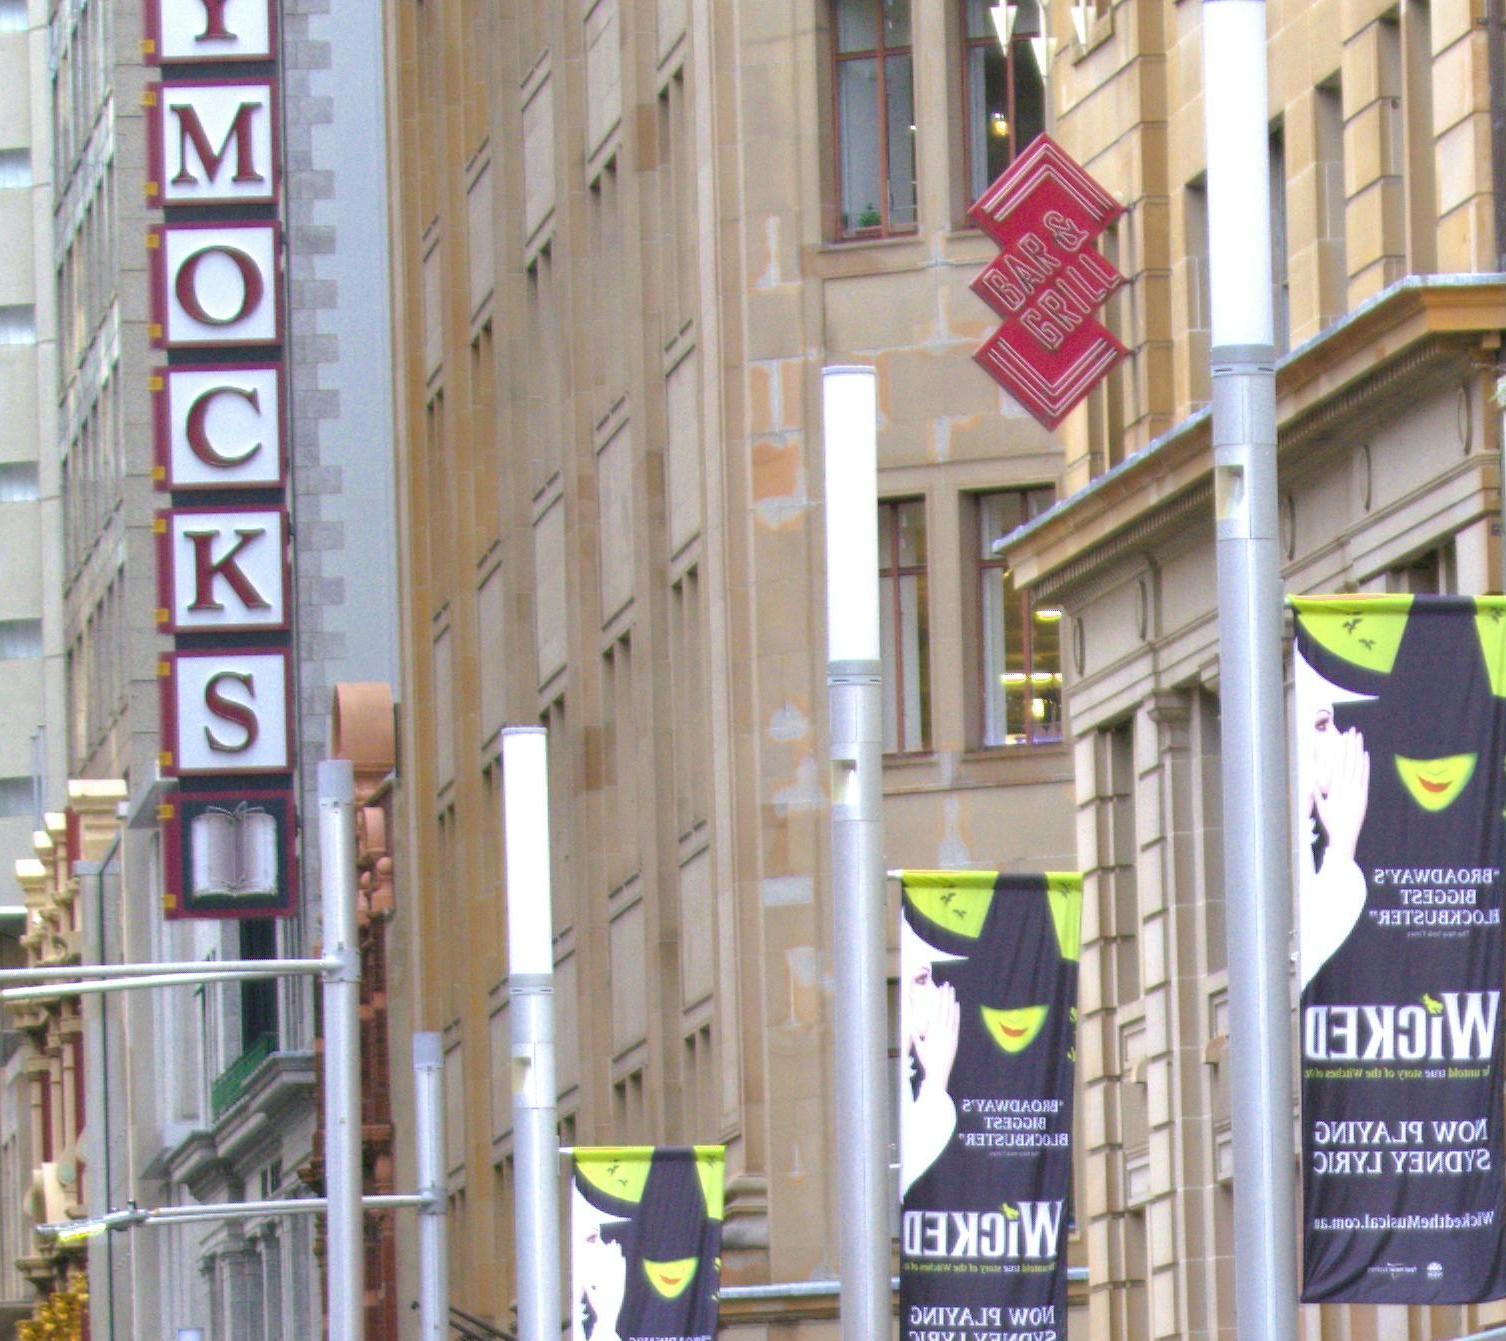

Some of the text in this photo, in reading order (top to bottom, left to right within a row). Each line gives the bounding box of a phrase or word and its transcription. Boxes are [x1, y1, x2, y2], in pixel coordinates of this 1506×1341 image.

[982, 210, 1090, 312] BAR &
[1020, 253, 1120, 350] GRILL
